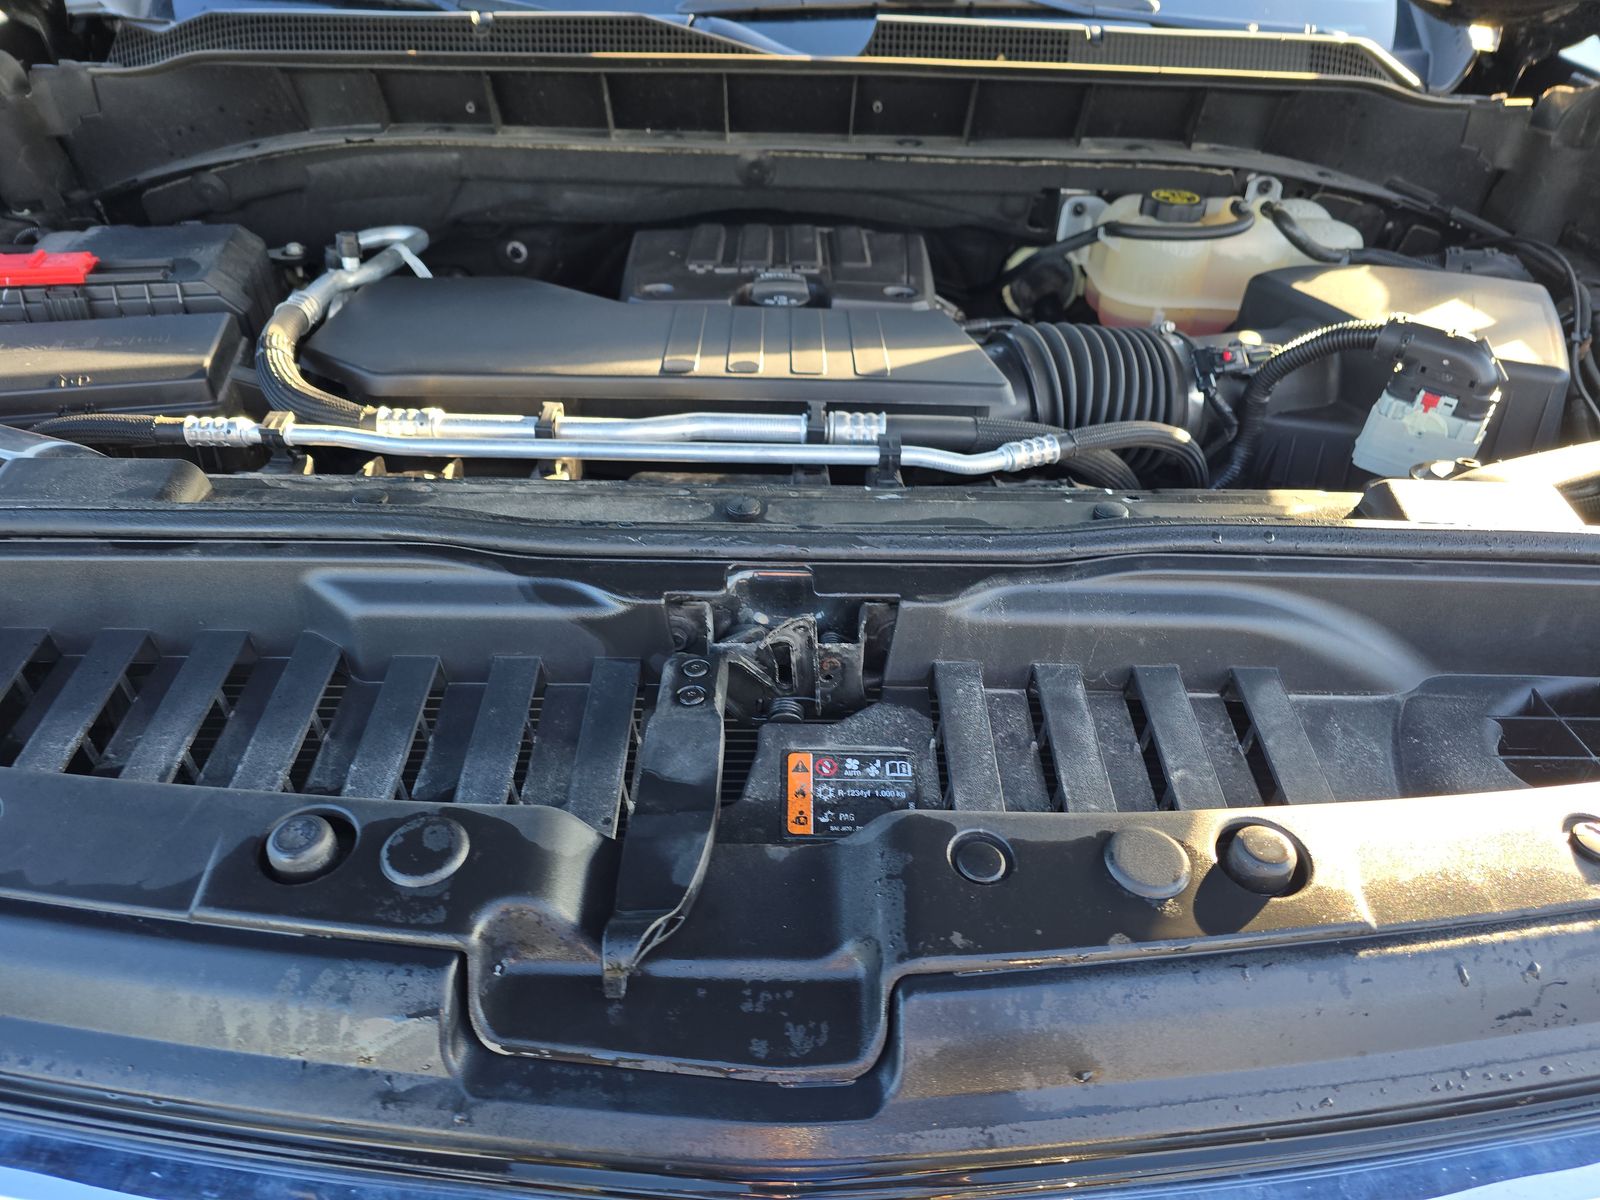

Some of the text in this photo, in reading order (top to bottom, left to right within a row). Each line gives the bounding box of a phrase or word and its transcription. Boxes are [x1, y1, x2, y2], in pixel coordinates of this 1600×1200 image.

[837, 790, 906, 799] R-1234yf 1.000 kg
[839, 813, 855, 822] PAG
